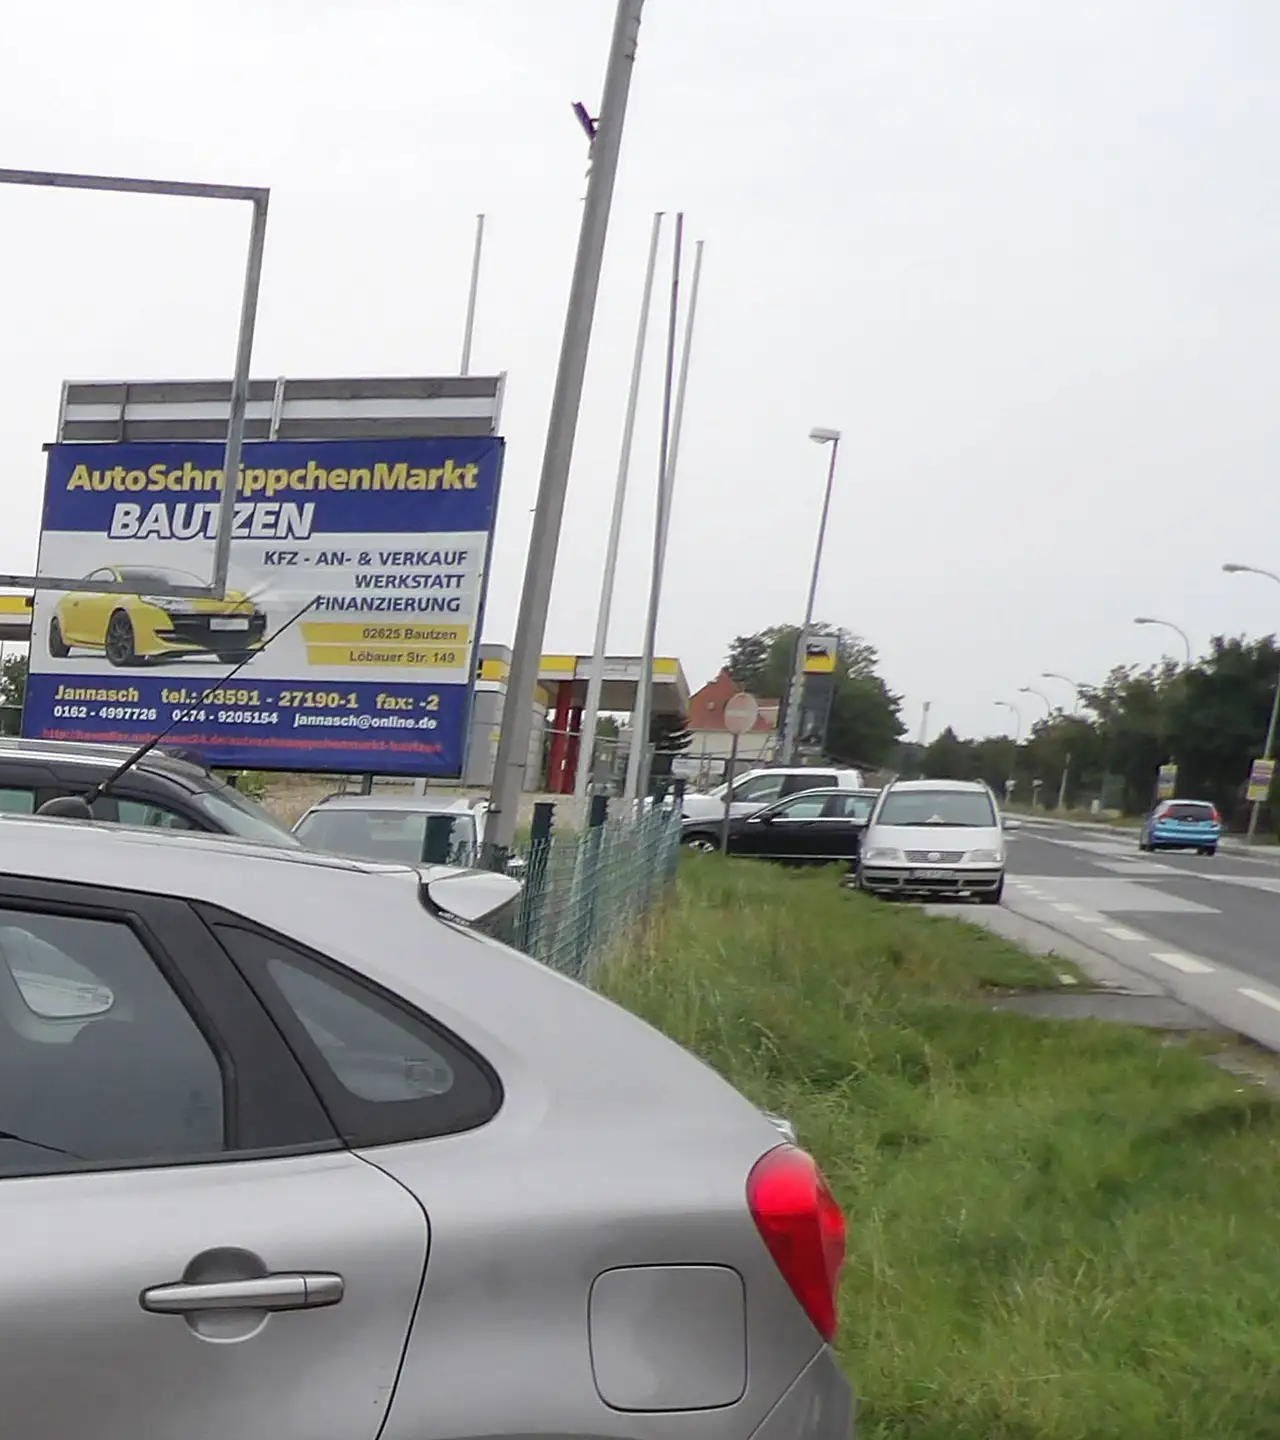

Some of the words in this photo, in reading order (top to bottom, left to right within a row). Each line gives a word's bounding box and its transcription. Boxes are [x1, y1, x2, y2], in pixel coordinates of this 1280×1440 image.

[109, 502, 315, 539] BAUTZEN
[263, 550, 299, 566] KFZ
[315, 550, 352, 566] AN-
[357, 550, 372, 567] &
[378, 550, 468, 566] VERKAUF
[354, 573, 465, 589] WERKSTATT
[315, 596, 461, 612] FINANZIERUNG
[362, 628, 401, 640] 02625
[403, 628, 458, 640] Bautzen
[349, 648, 403, 662] Löbauer
[406, 651, 428, 663] Str.
[433, 652, 456, 663] 149
[54, 685, 140, 703] Jannasch
[161, 688, 198, 704] tel.:
[202, 688, 261, 706] 03591
[278, 691, 359, 709] 27190-1
[375, 693, 414, 710] fax:
[418, 694, 440, 711] -2
[53, 705, 87, 718] 0162
[98, 706, 157, 720] 4997726
[217, 710, 279, 725] 9205154
[292, 712, 438, 730] jannasch@online.de
